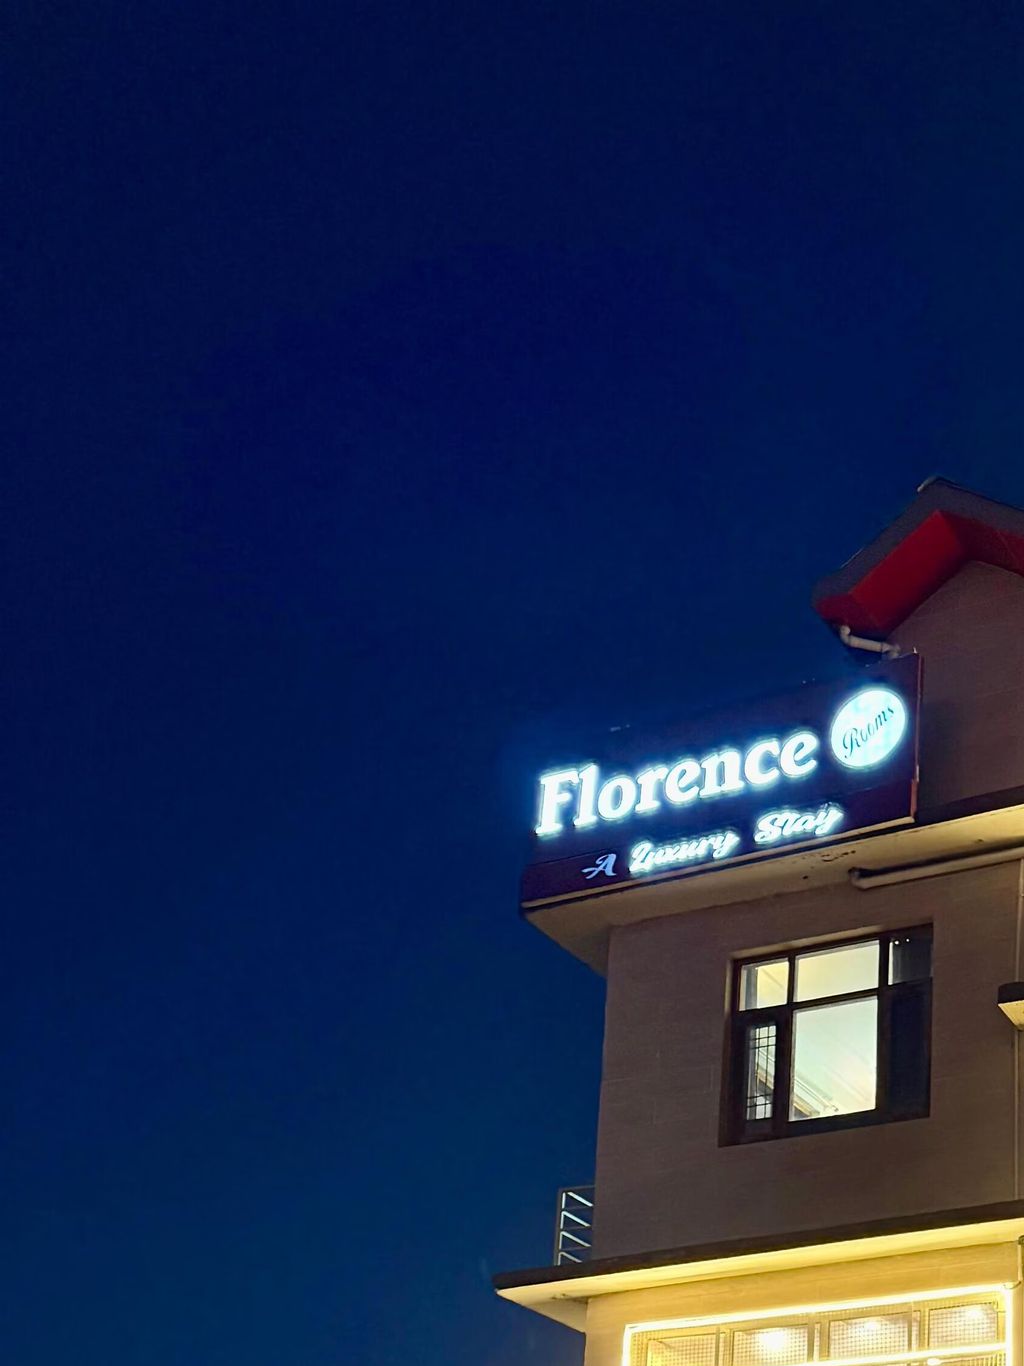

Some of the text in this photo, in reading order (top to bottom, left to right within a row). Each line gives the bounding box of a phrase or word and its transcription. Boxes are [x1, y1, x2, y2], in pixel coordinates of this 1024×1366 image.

[842, 706, 894, 759] Rooms
[534, 730, 819, 836] Florence
[582, 804, 844, 879] A Luxury Stay
